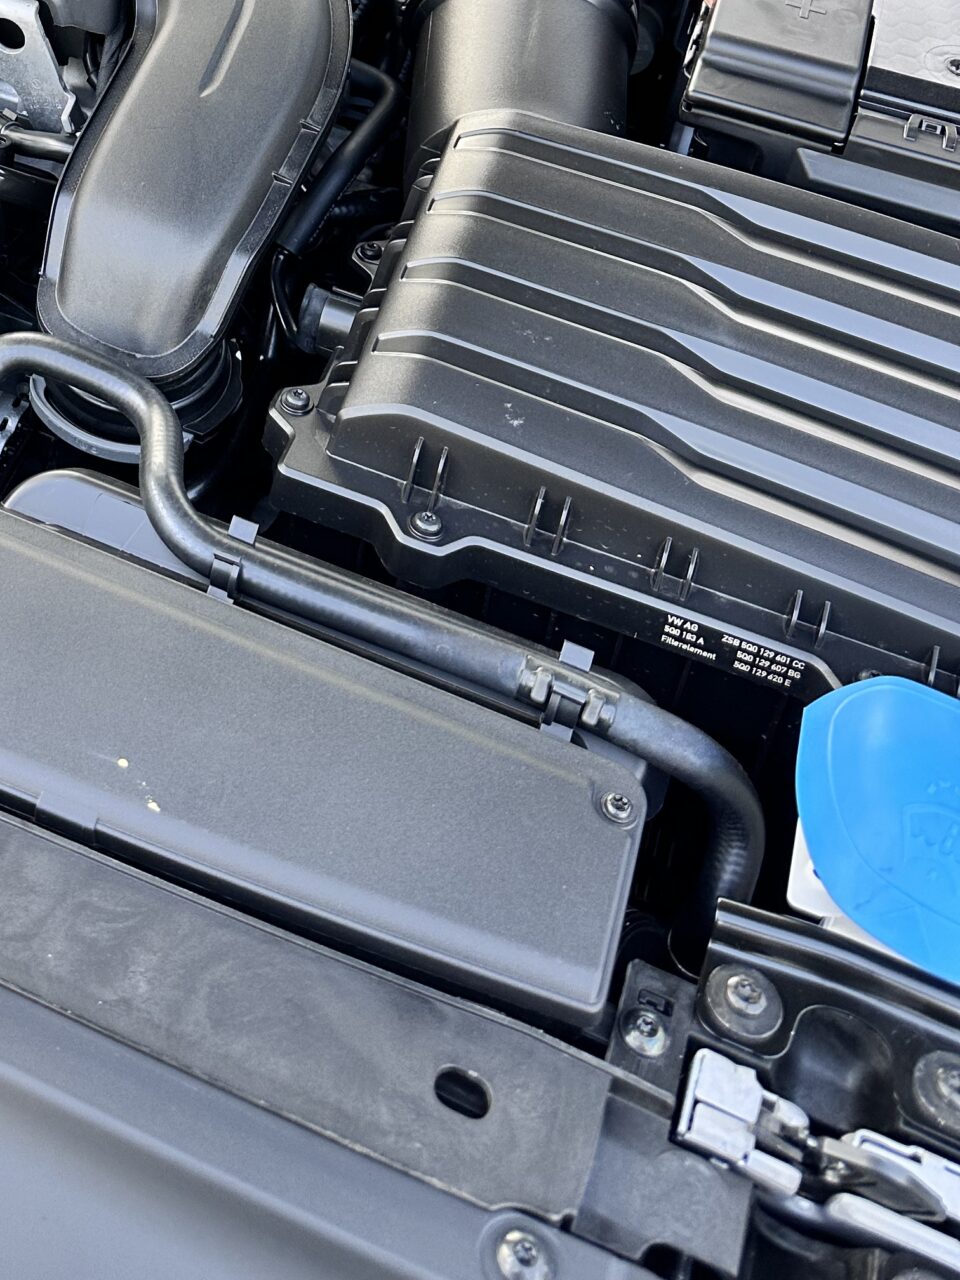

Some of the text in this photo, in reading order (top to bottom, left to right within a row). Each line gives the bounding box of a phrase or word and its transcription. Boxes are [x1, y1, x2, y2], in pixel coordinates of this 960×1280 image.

[667, 614, 699, 632] VW AG
[660, 634, 717, 661] Filterelement
[697, 637, 705, 646] A
[721, 634, 740, 647] ZSB
[759, 647, 775, 659] 129
[775, 653, 791, 665] 601
[792, 658, 806, 670] CC
[751, 666, 767, 678] 129
[767, 672, 784, 684] 620
[784, 678, 792, 687] E
[754, 656, 771, 668] 129
[770, 662, 786, 674] 607
[787, 668, 802, 679] BG
